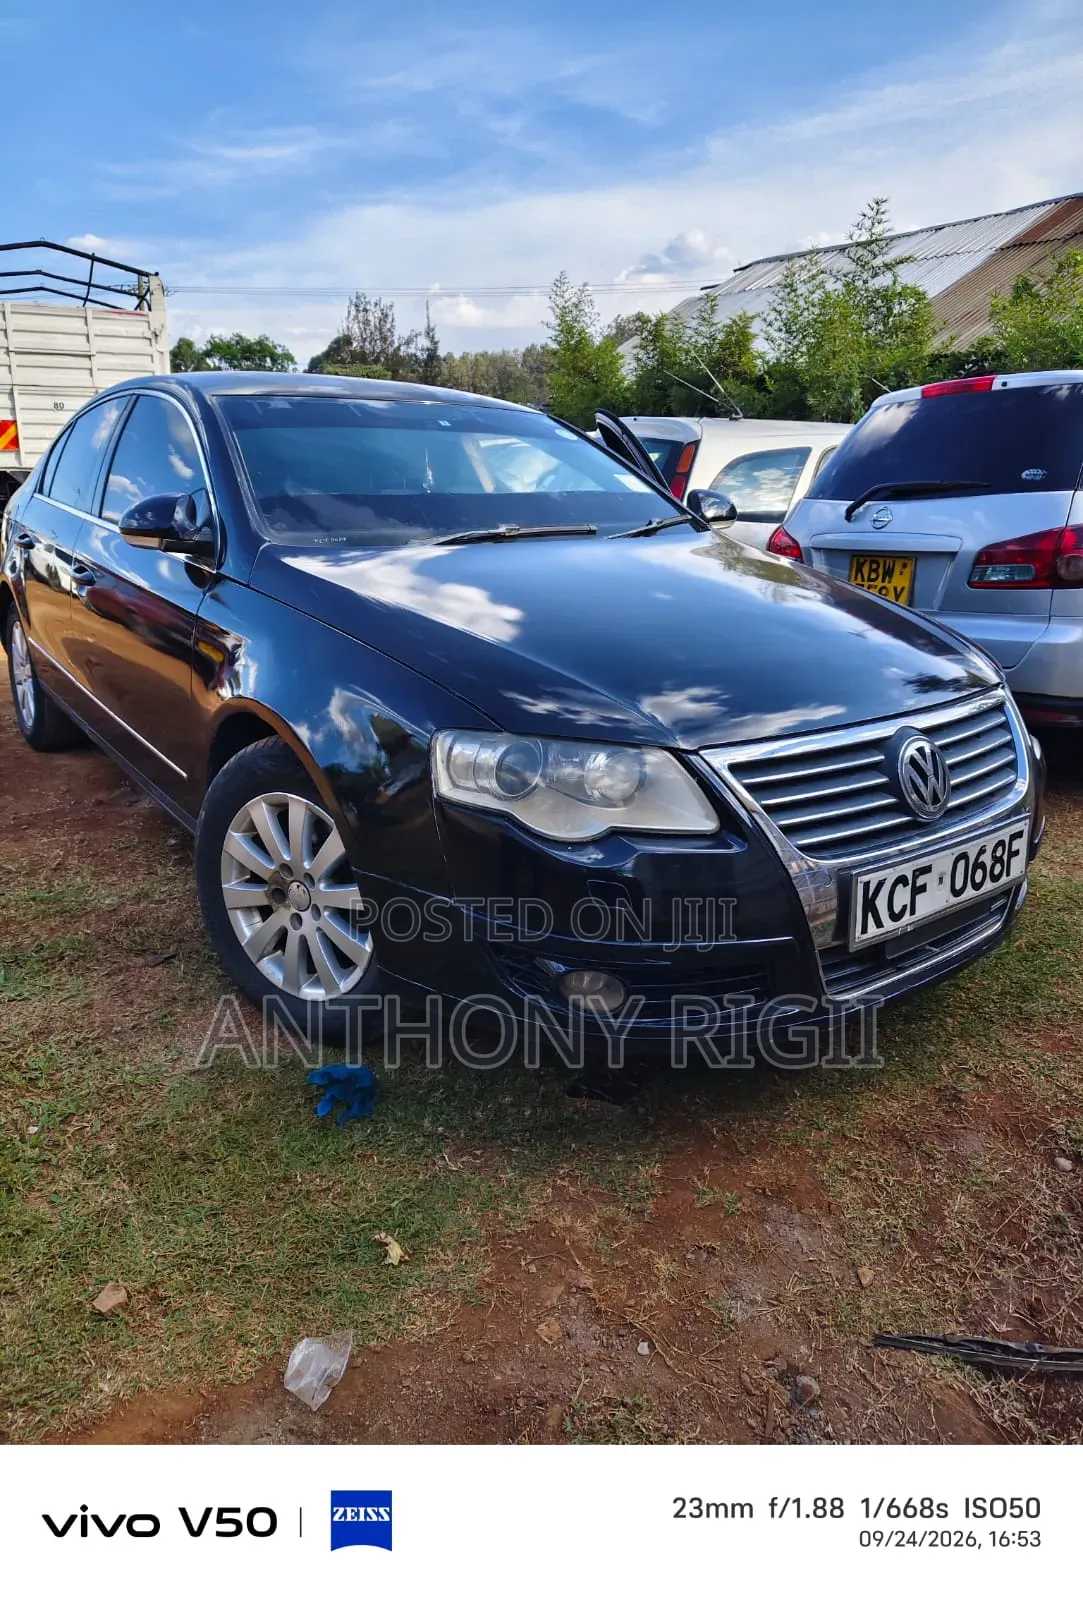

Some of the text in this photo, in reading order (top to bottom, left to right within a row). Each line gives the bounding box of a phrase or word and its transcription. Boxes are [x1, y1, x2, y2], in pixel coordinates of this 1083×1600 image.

[854, 558, 896, 584] KBW
[900, 738, 950, 817] VW
[860, 829, 1025, 935] KCF 068F
